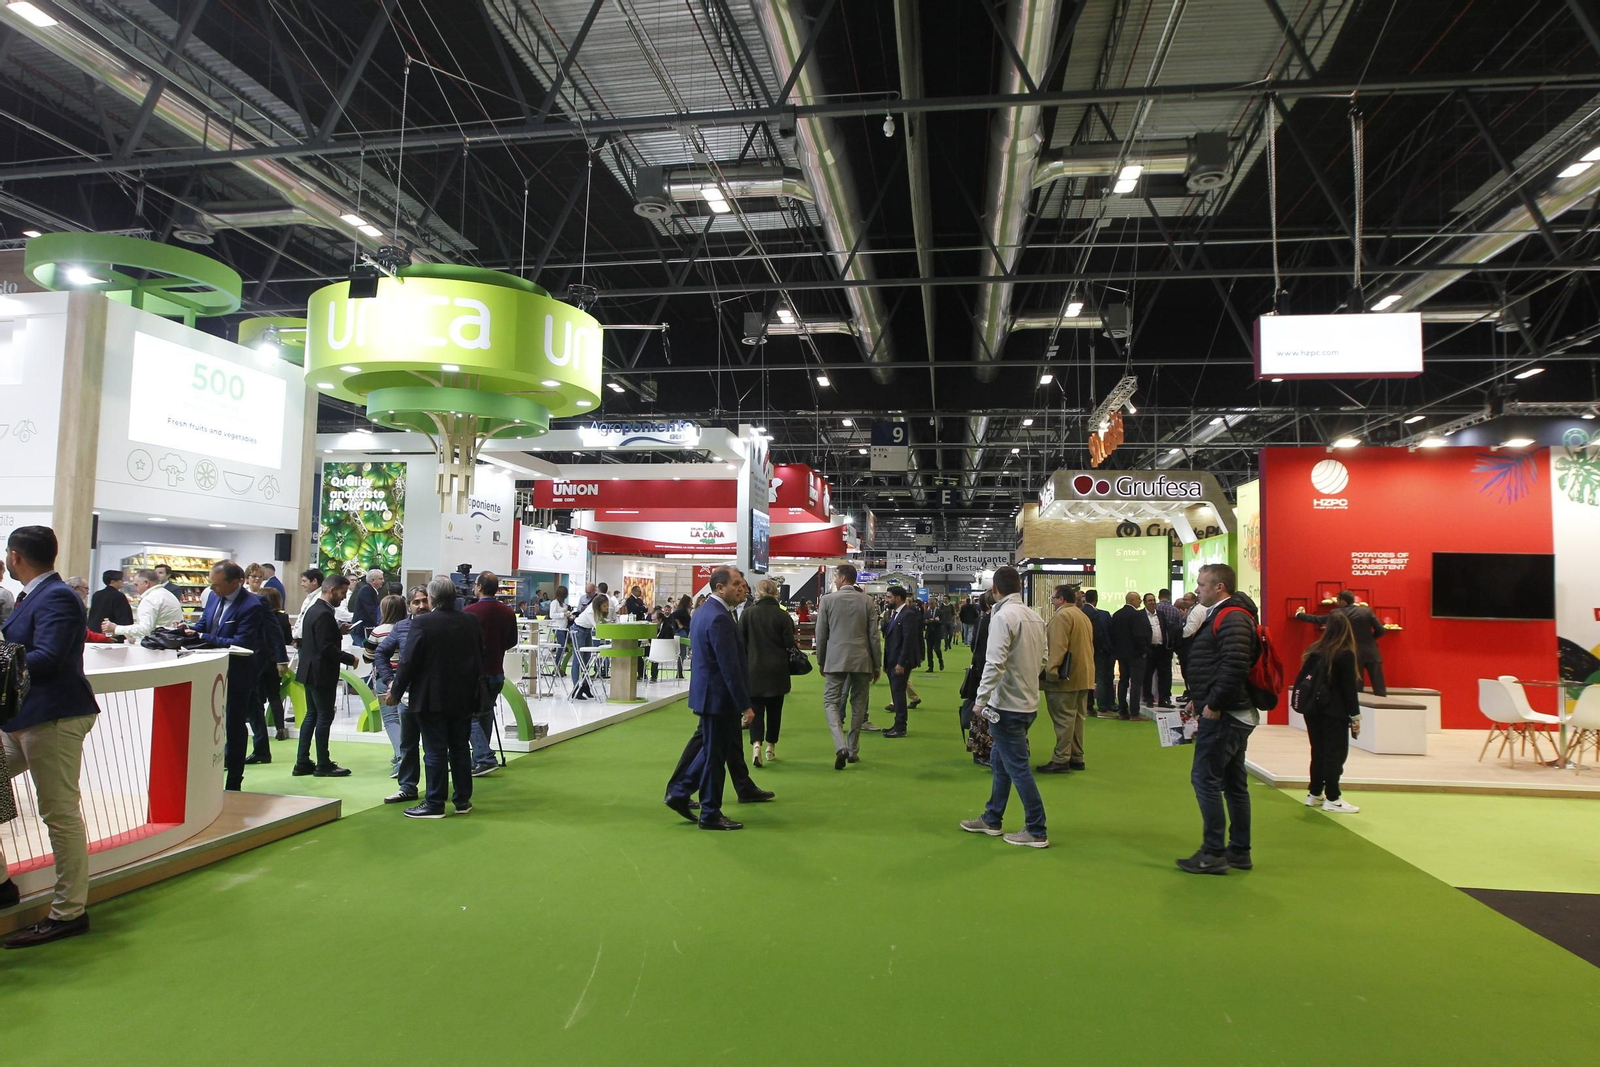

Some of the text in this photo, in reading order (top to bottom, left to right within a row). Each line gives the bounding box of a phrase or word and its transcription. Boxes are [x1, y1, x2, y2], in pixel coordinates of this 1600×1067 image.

[192, 362, 245, 401] 500
[167, 417, 257, 444] Fresh fruits and vegetables
[590, 419, 694, 437] Agroponiente
[892, 426, 904, 443] 9
[330, 475, 375, 489] Quality
[1115, 474, 1203, 498] Grufesa
[329, 489, 386, 499] and taste
[552, 483, 599, 496] UNION
[941, 489, 951, 505] E
[1313, 498, 1349, 507] HZPC
[328, 500, 389, 511] in our DNA
[702, 530, 725, 538] CAÑA
[925, 525, 931, 534] 9
[953, 554, 1007, 563] Restaurante
[1125, 576, 1137, 588] In
